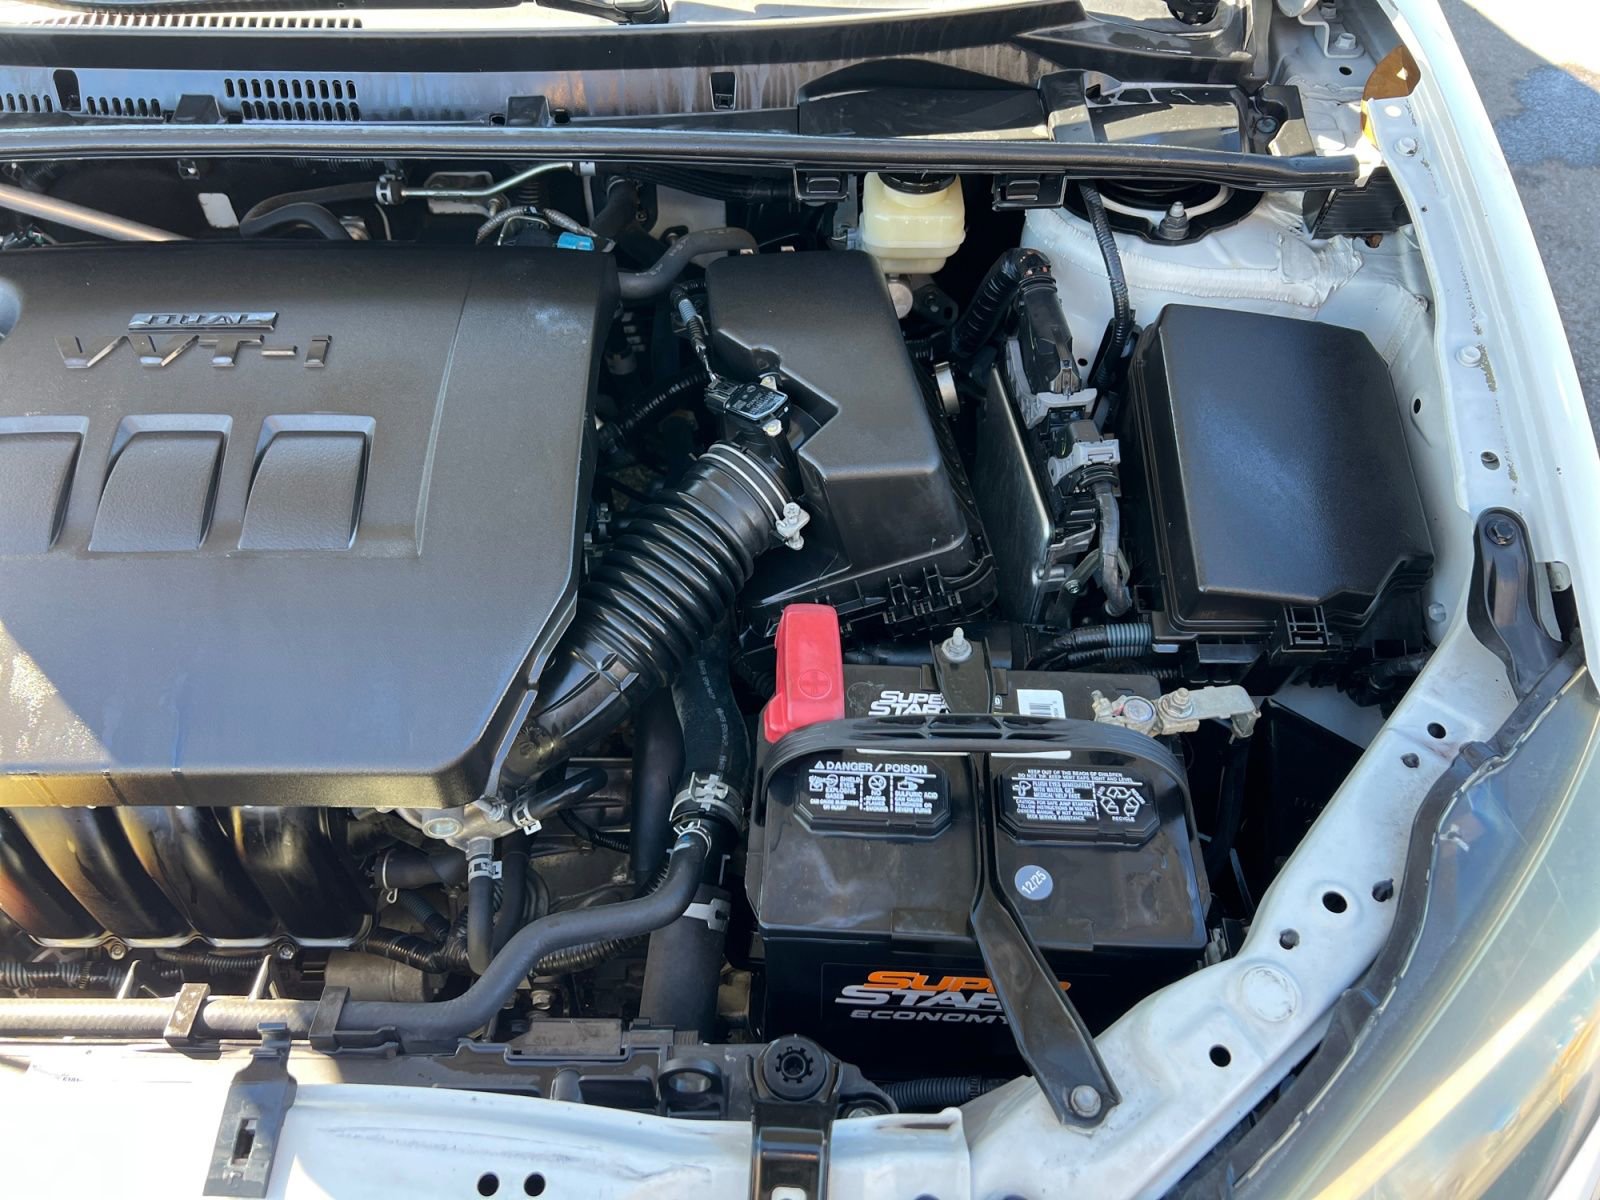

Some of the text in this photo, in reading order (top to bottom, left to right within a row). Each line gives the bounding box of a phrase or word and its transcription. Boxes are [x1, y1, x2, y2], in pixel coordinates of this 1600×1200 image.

[879, 690, 946, 704] SUPE
[826, 761, 928, 774] DANGER / POISON
[924, 792, 938, 800] ACID
[1021, 870, 1047, 894] 12/25
